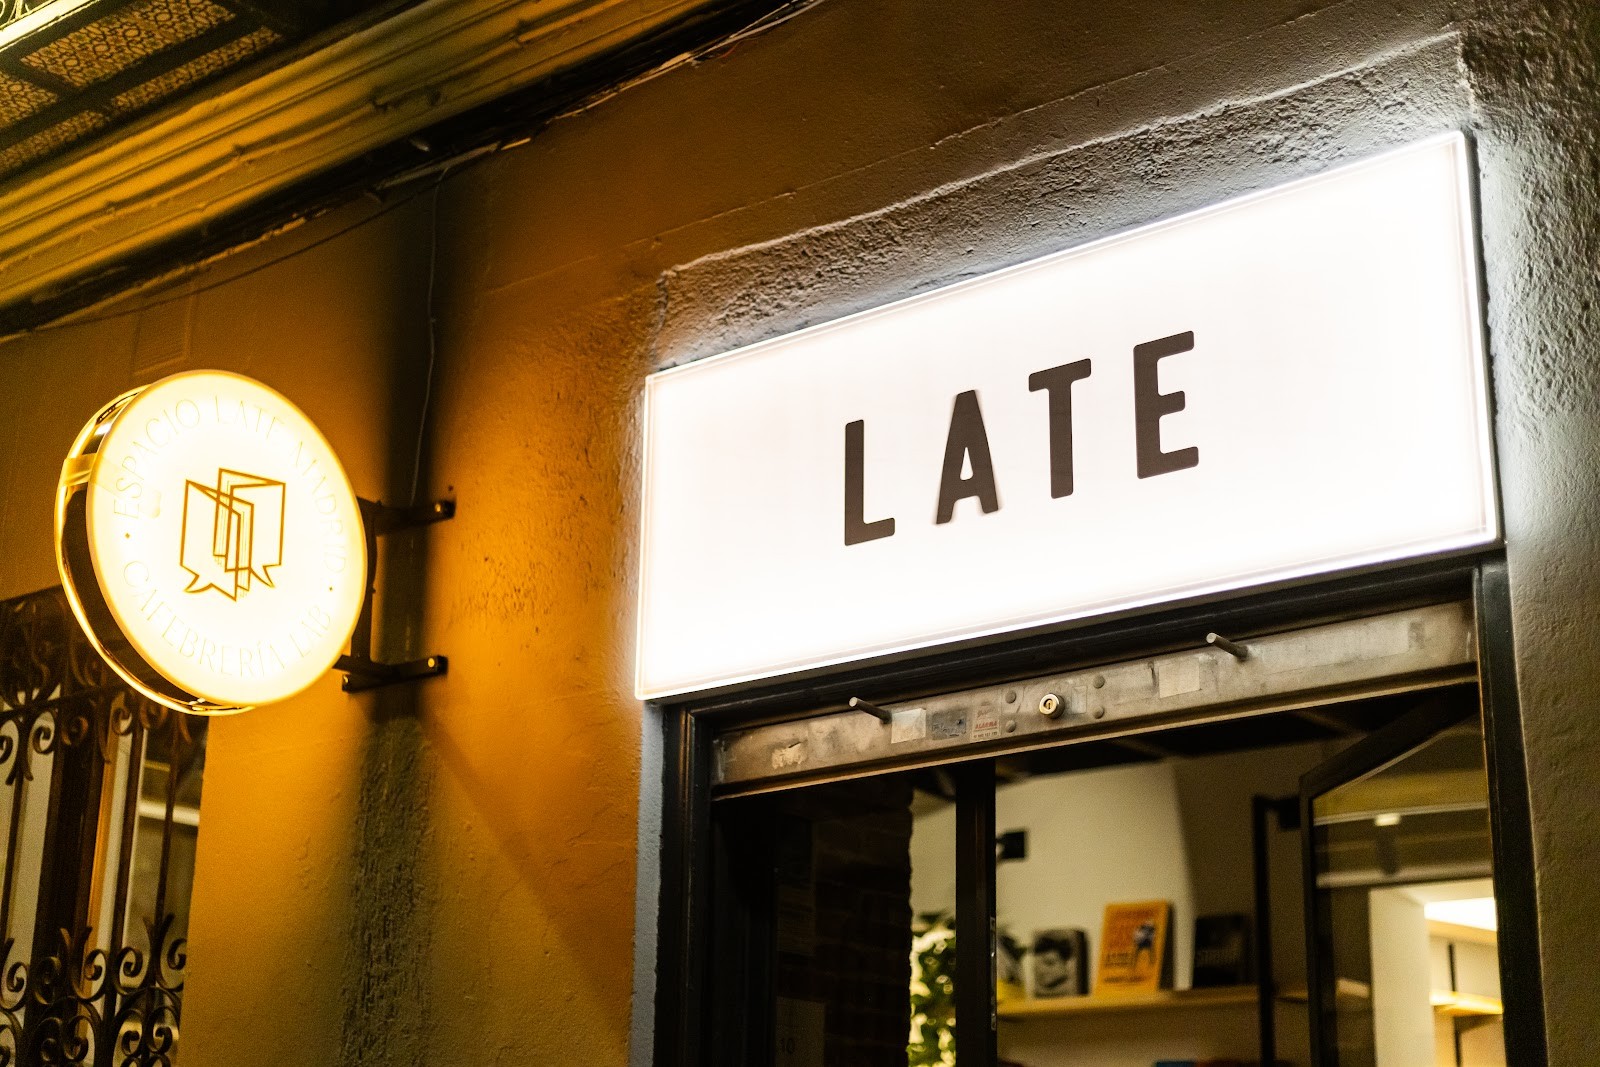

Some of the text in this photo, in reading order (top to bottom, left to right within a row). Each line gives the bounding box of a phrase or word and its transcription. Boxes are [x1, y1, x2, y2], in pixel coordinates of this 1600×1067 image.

[113, 398, 201, 519] ESPACIO
[214, 394, 285, 440] LATE
[844, 330, 1200, 546] LATE
[290, 603, 332, 658] LAB
